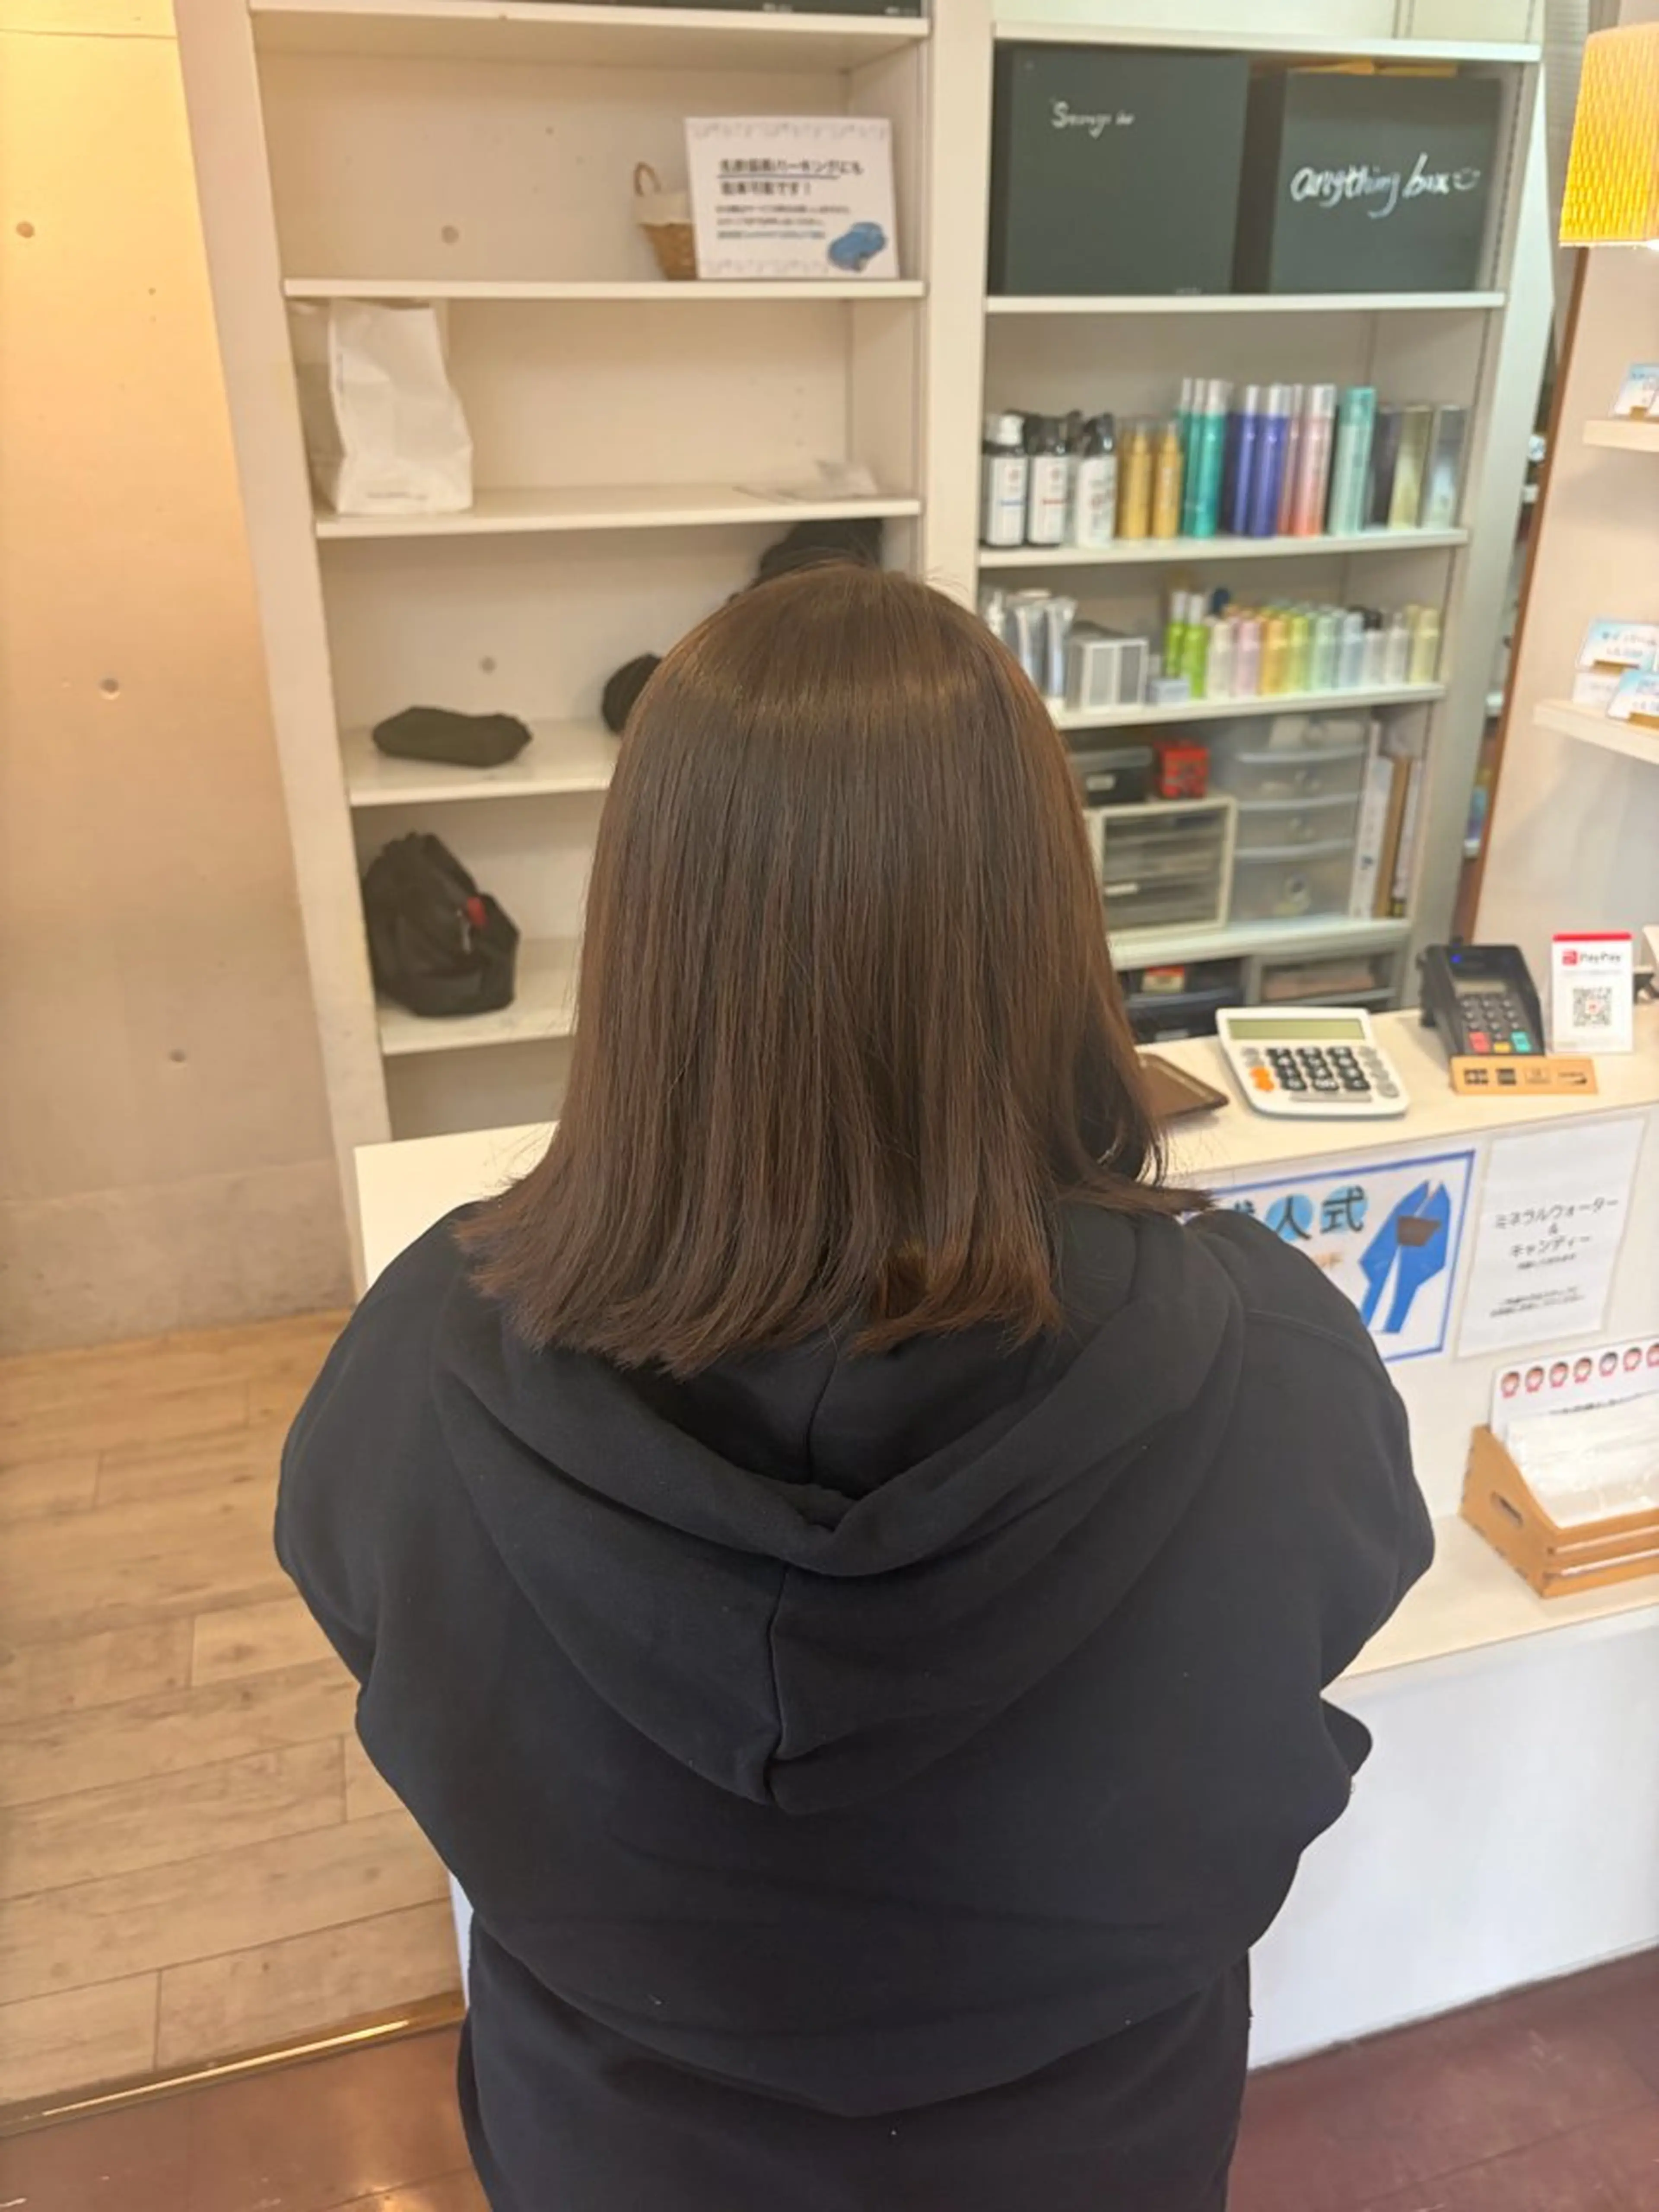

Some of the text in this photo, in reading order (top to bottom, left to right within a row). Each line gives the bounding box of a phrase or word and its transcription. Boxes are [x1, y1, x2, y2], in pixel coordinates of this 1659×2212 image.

[1290, 164, 1401, 219] anything
[1580, 952, 1621, 965] PayPay
[1232, 1185, 1364, 1240] 人式
[1495, 1197, 1619, 1229] ミネラルウォーター
[1510, 1234, 1591, 1258] キャンディー
